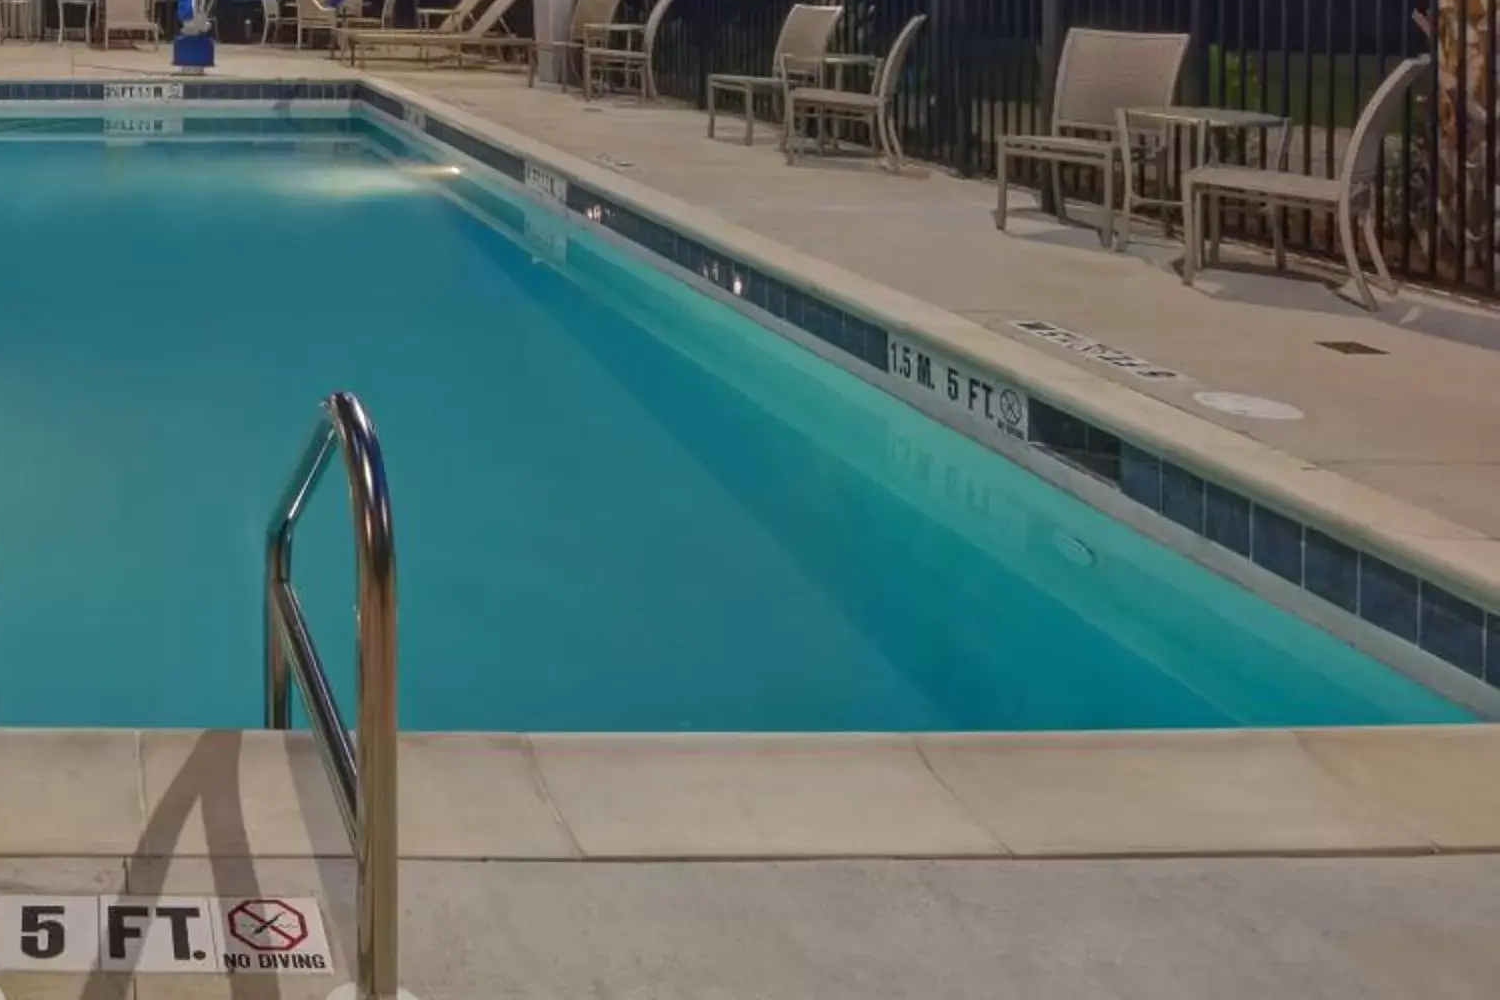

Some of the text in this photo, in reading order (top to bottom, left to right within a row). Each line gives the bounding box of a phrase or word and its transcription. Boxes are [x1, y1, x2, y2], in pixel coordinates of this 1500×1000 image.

[890, 342, 995, 420] 1.5 M. 5 FT.
[20, 905, 65, 958] 5
[107, 906, 206, 961] FT.
[223, 953, 326, 969] NO DIVING
